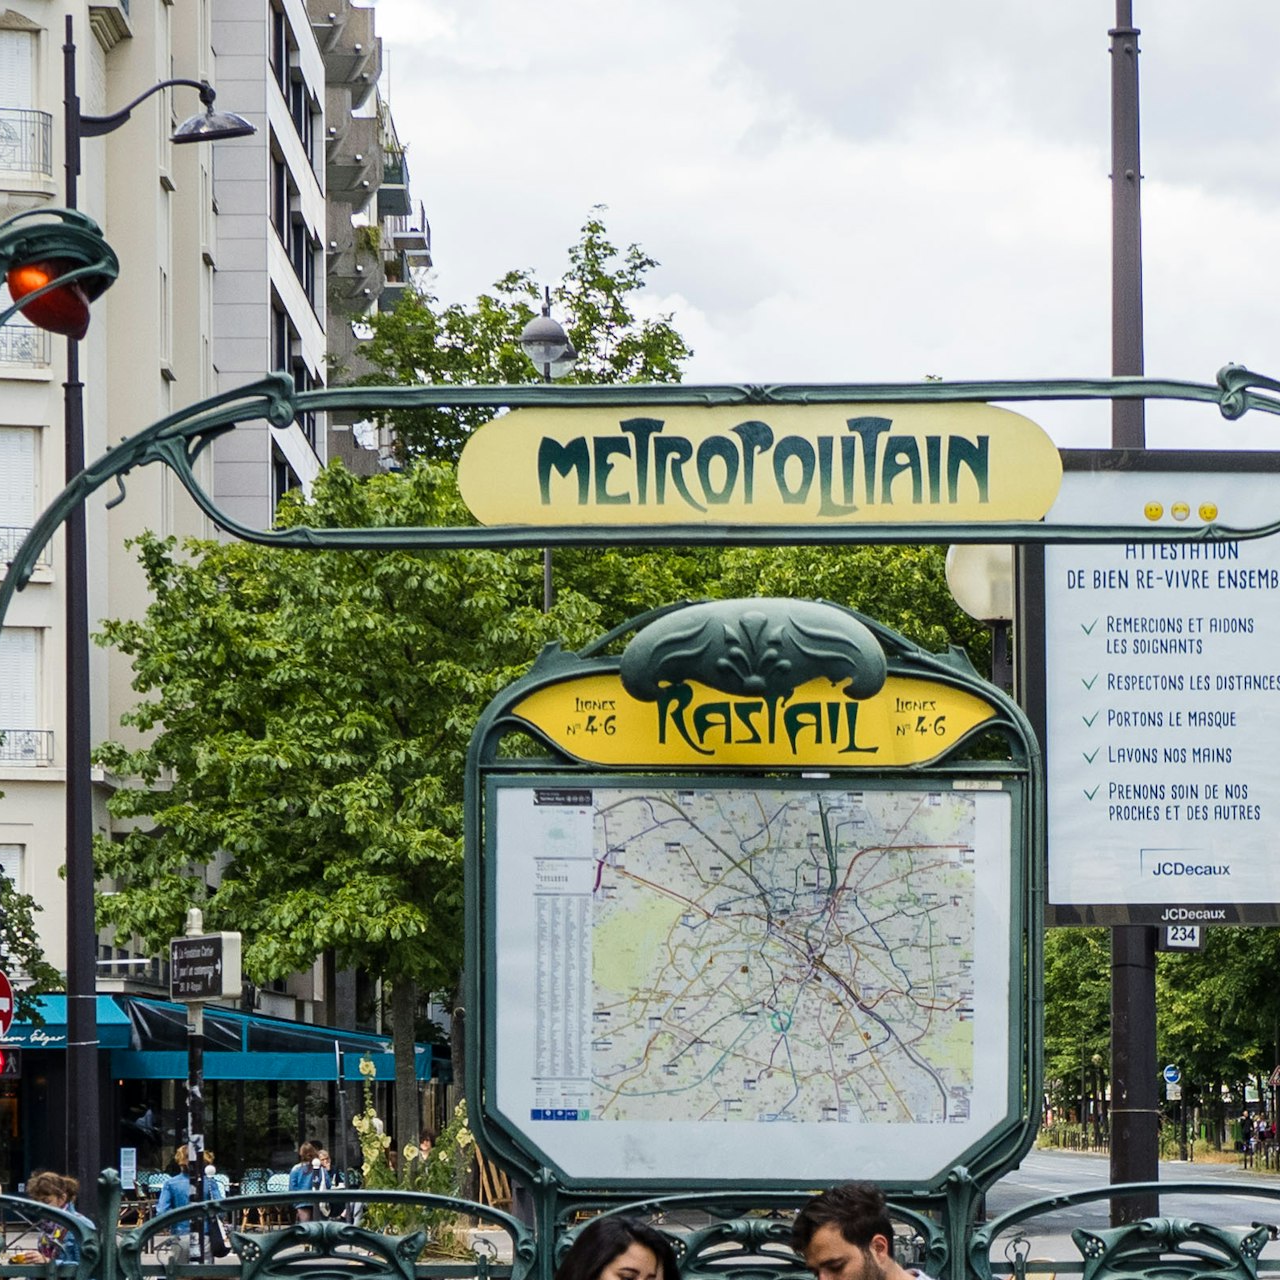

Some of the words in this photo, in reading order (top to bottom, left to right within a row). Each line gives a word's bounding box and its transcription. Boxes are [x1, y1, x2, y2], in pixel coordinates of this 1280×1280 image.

[538, 416, 990, 517] METROPOLITAIN
[1068, 570, 1085, 589] DE
[1094, 570, 1128, 589] BIEN
[1137, 569, 1209, 589] RE-VIVRE
[1107, 616, 1182, 634] REMERCIONS
[1189, 618, 1203, 633] ET
[1210, 618, 1253, 633] AIDONS
[1107, 639, 1127, 654] LES
[1133, 639, 1202, 654] SOIGNANTS
[1108, 673, 1184, 691] RESPECTONS
[1190, 675, 1210, 691] LES
[574, 697, 616, 713] LIGNES
[895, 697, 936, 713] LIGNES
[656, 682, 879, 755] RASPAIL
[1108, 709, 1163, 727] PORTONS
[1169, 712, 1182, 727] LE
[1188, 711, 1236, 728] MASQUE
[1109, 746, 1157, 763] LAVONS
[1164, 748, 1186, 763] NOS
[1193, 748, 1232, 763] MAINS
[1109, 782, 1165, 800] PRENONS
[1171, 784, 1198, 800] SOIN
[1205, 784, 1218, 799] DE
[1225, 784, 1247, 799] NOS
[1109, 805, 1159, 821] PROCHES
[1166, 805, 1180, 820] ET
[1187, 805, 1208, 821] DES
[1214, 805, 1260, 820] AUTRES
[1153, 862, 1230, 875] JCDecaux
[1161, 908, 1226, 921] JCDecaux
[1171, 926, 1196, 941] 234
